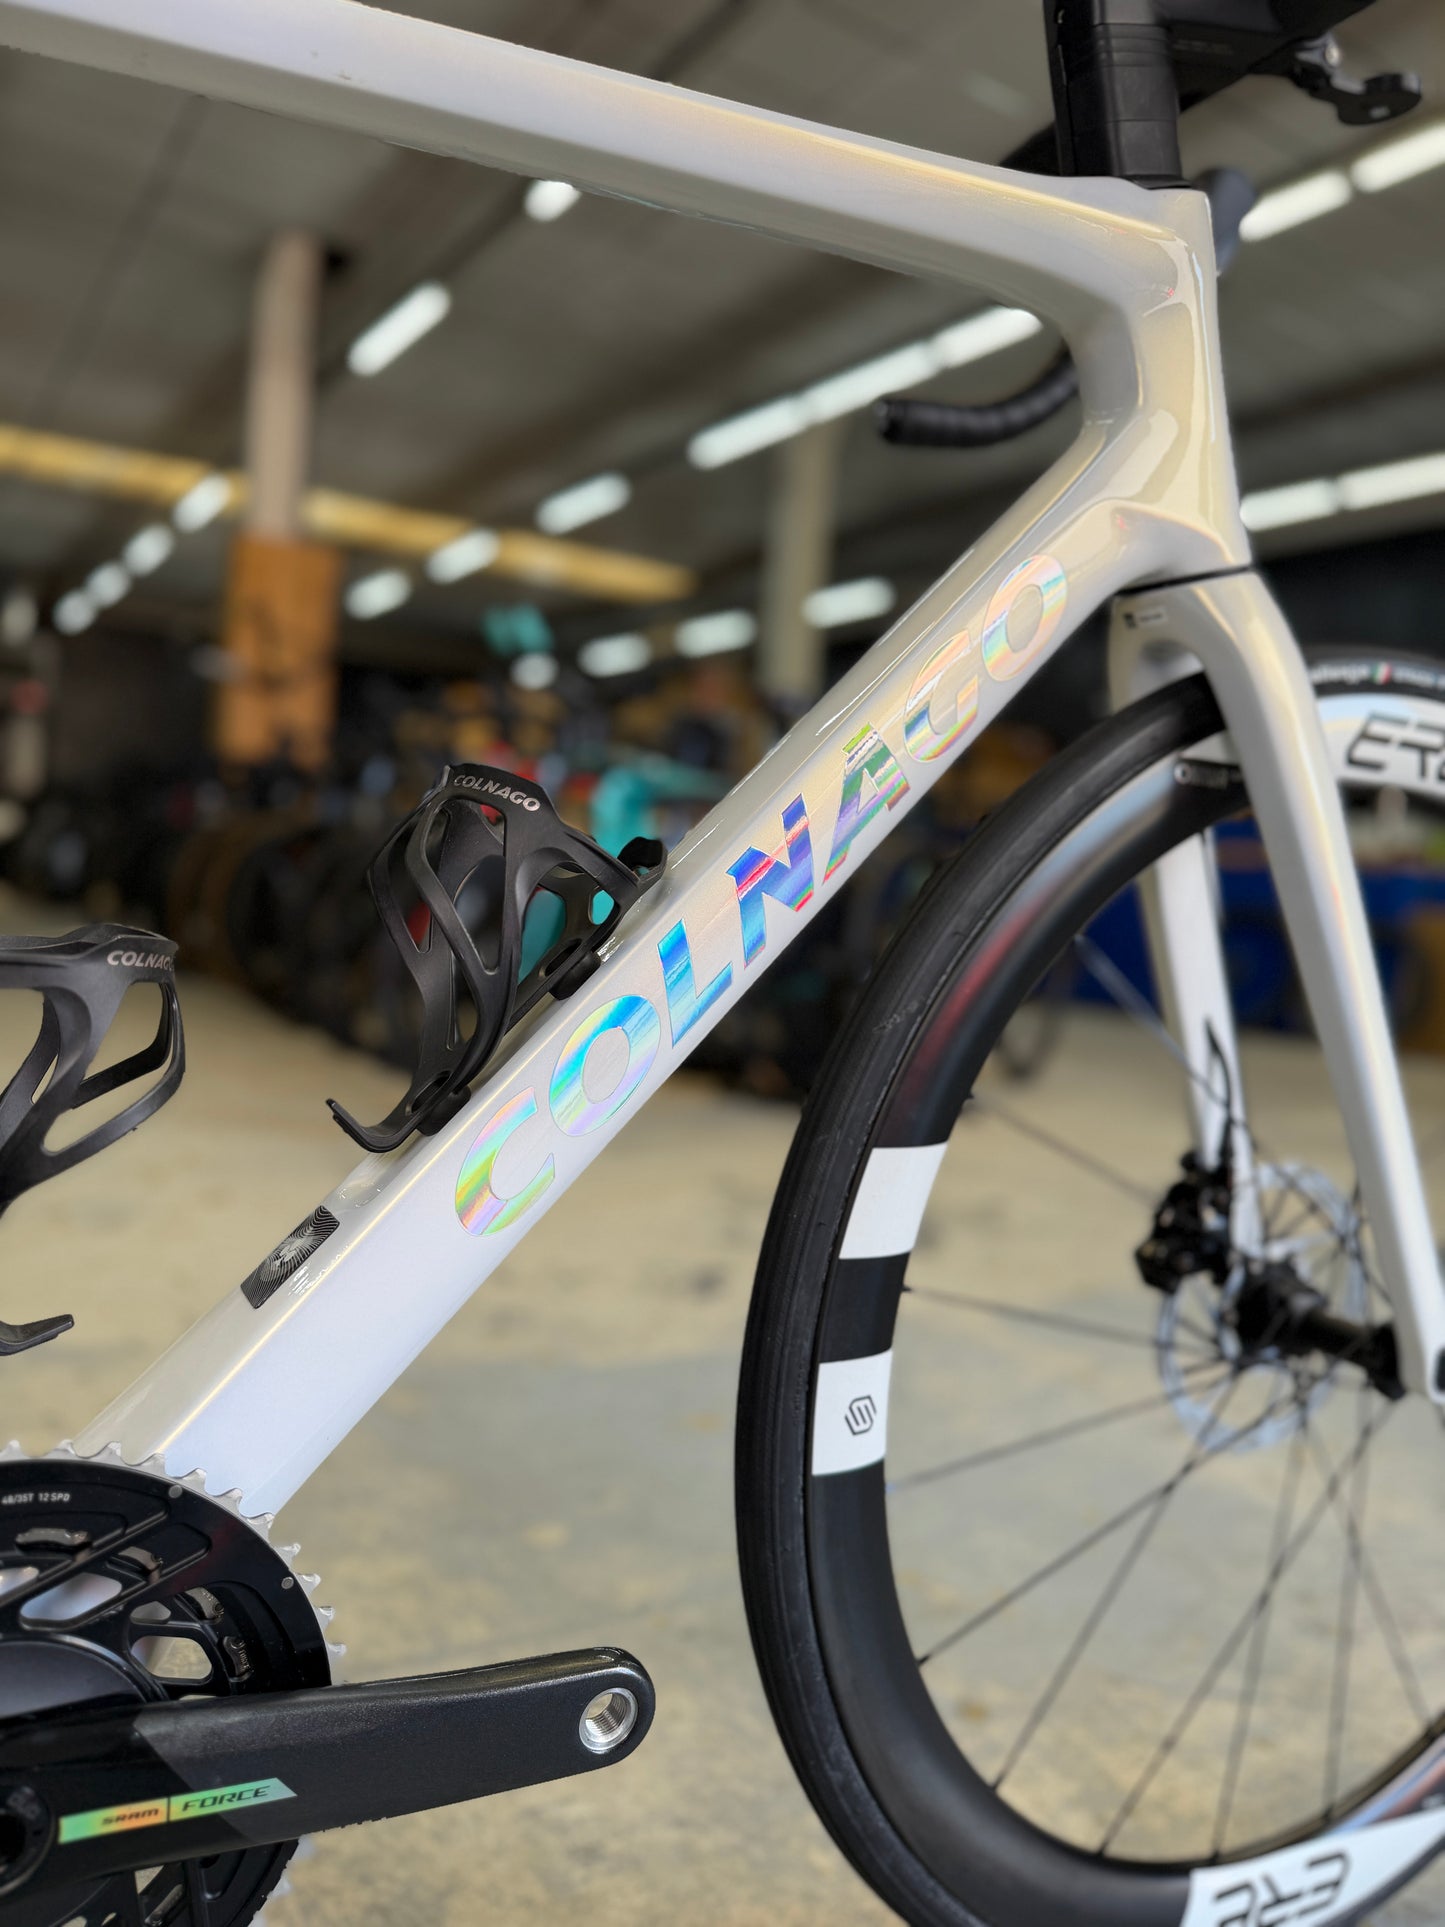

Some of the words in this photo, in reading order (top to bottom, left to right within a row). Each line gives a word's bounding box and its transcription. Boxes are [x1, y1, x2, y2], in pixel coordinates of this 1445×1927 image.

[453, 775, 540, 811] COLNAGO
[456, 554, 1066, 1236] COLNAGO
[107, 950, 173, 971] COLNAG
[182, 1785, 271, 1811] FORCE
[101, 1808, 159, 1825] SRAM
